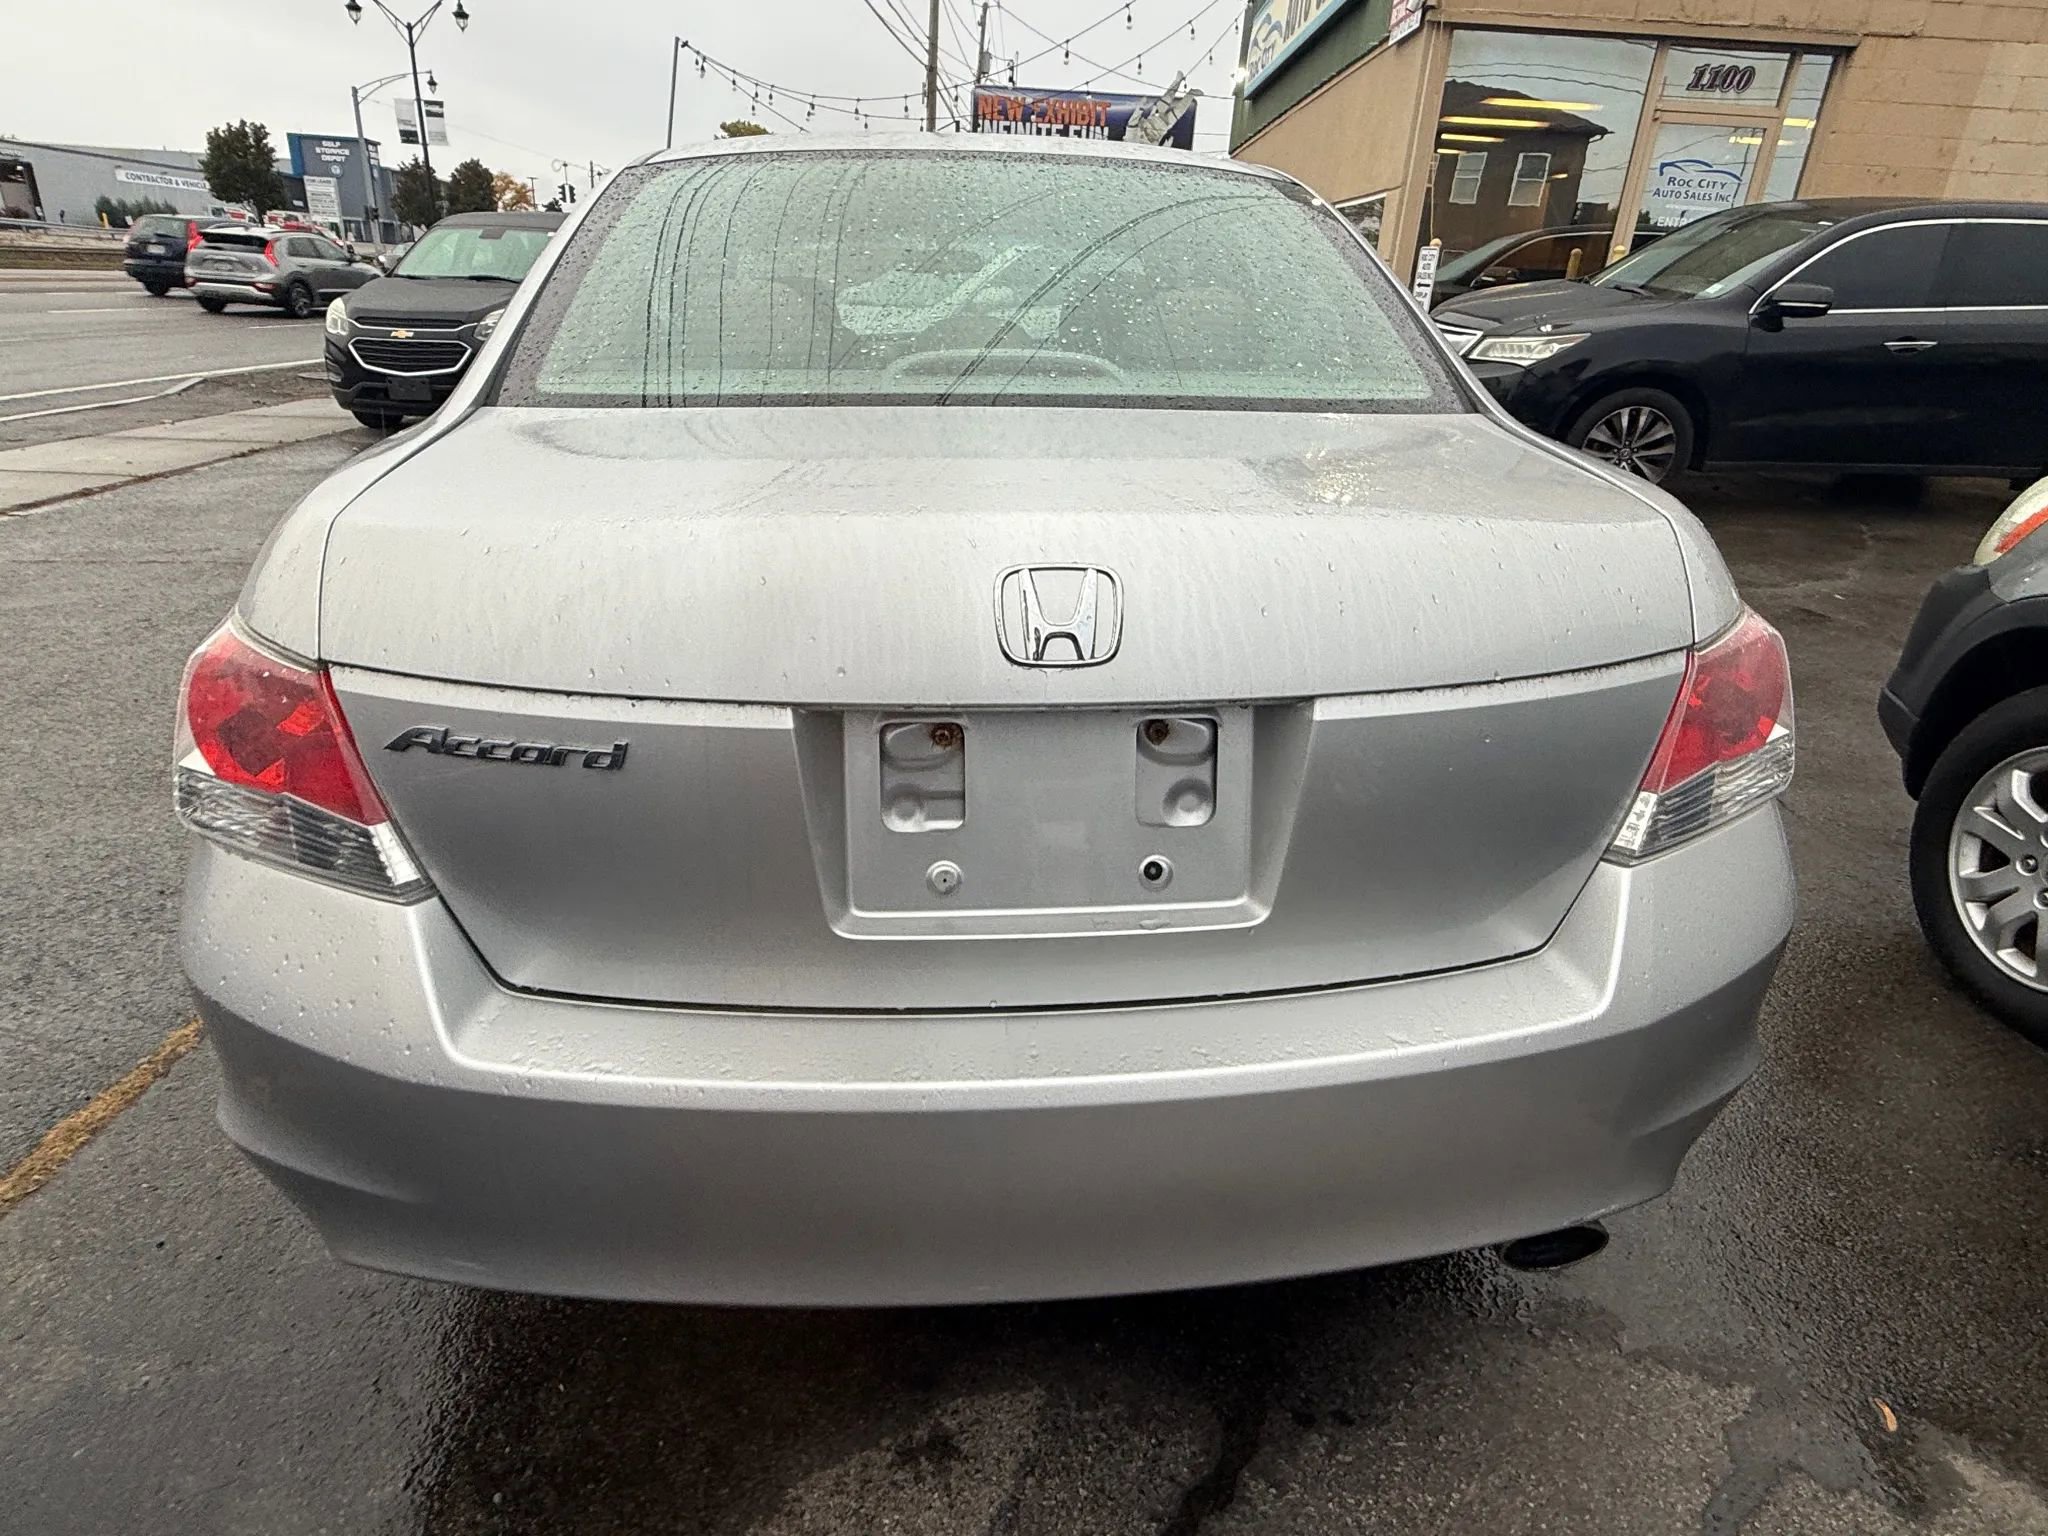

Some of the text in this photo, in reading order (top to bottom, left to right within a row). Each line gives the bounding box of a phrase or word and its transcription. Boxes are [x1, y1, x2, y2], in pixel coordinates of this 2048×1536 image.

[1686, 63, 1756, 94] 1100
[978, 94, 1112, 127] NEW EXHIBIT
[125, 171, 173, 186] CONTRACTOR
[1667, 176, 1728, 190] ROC CITY
[1652, 187, 1732, 203] AUTO SALES INC
[383, 723, 629, 770] Accord
